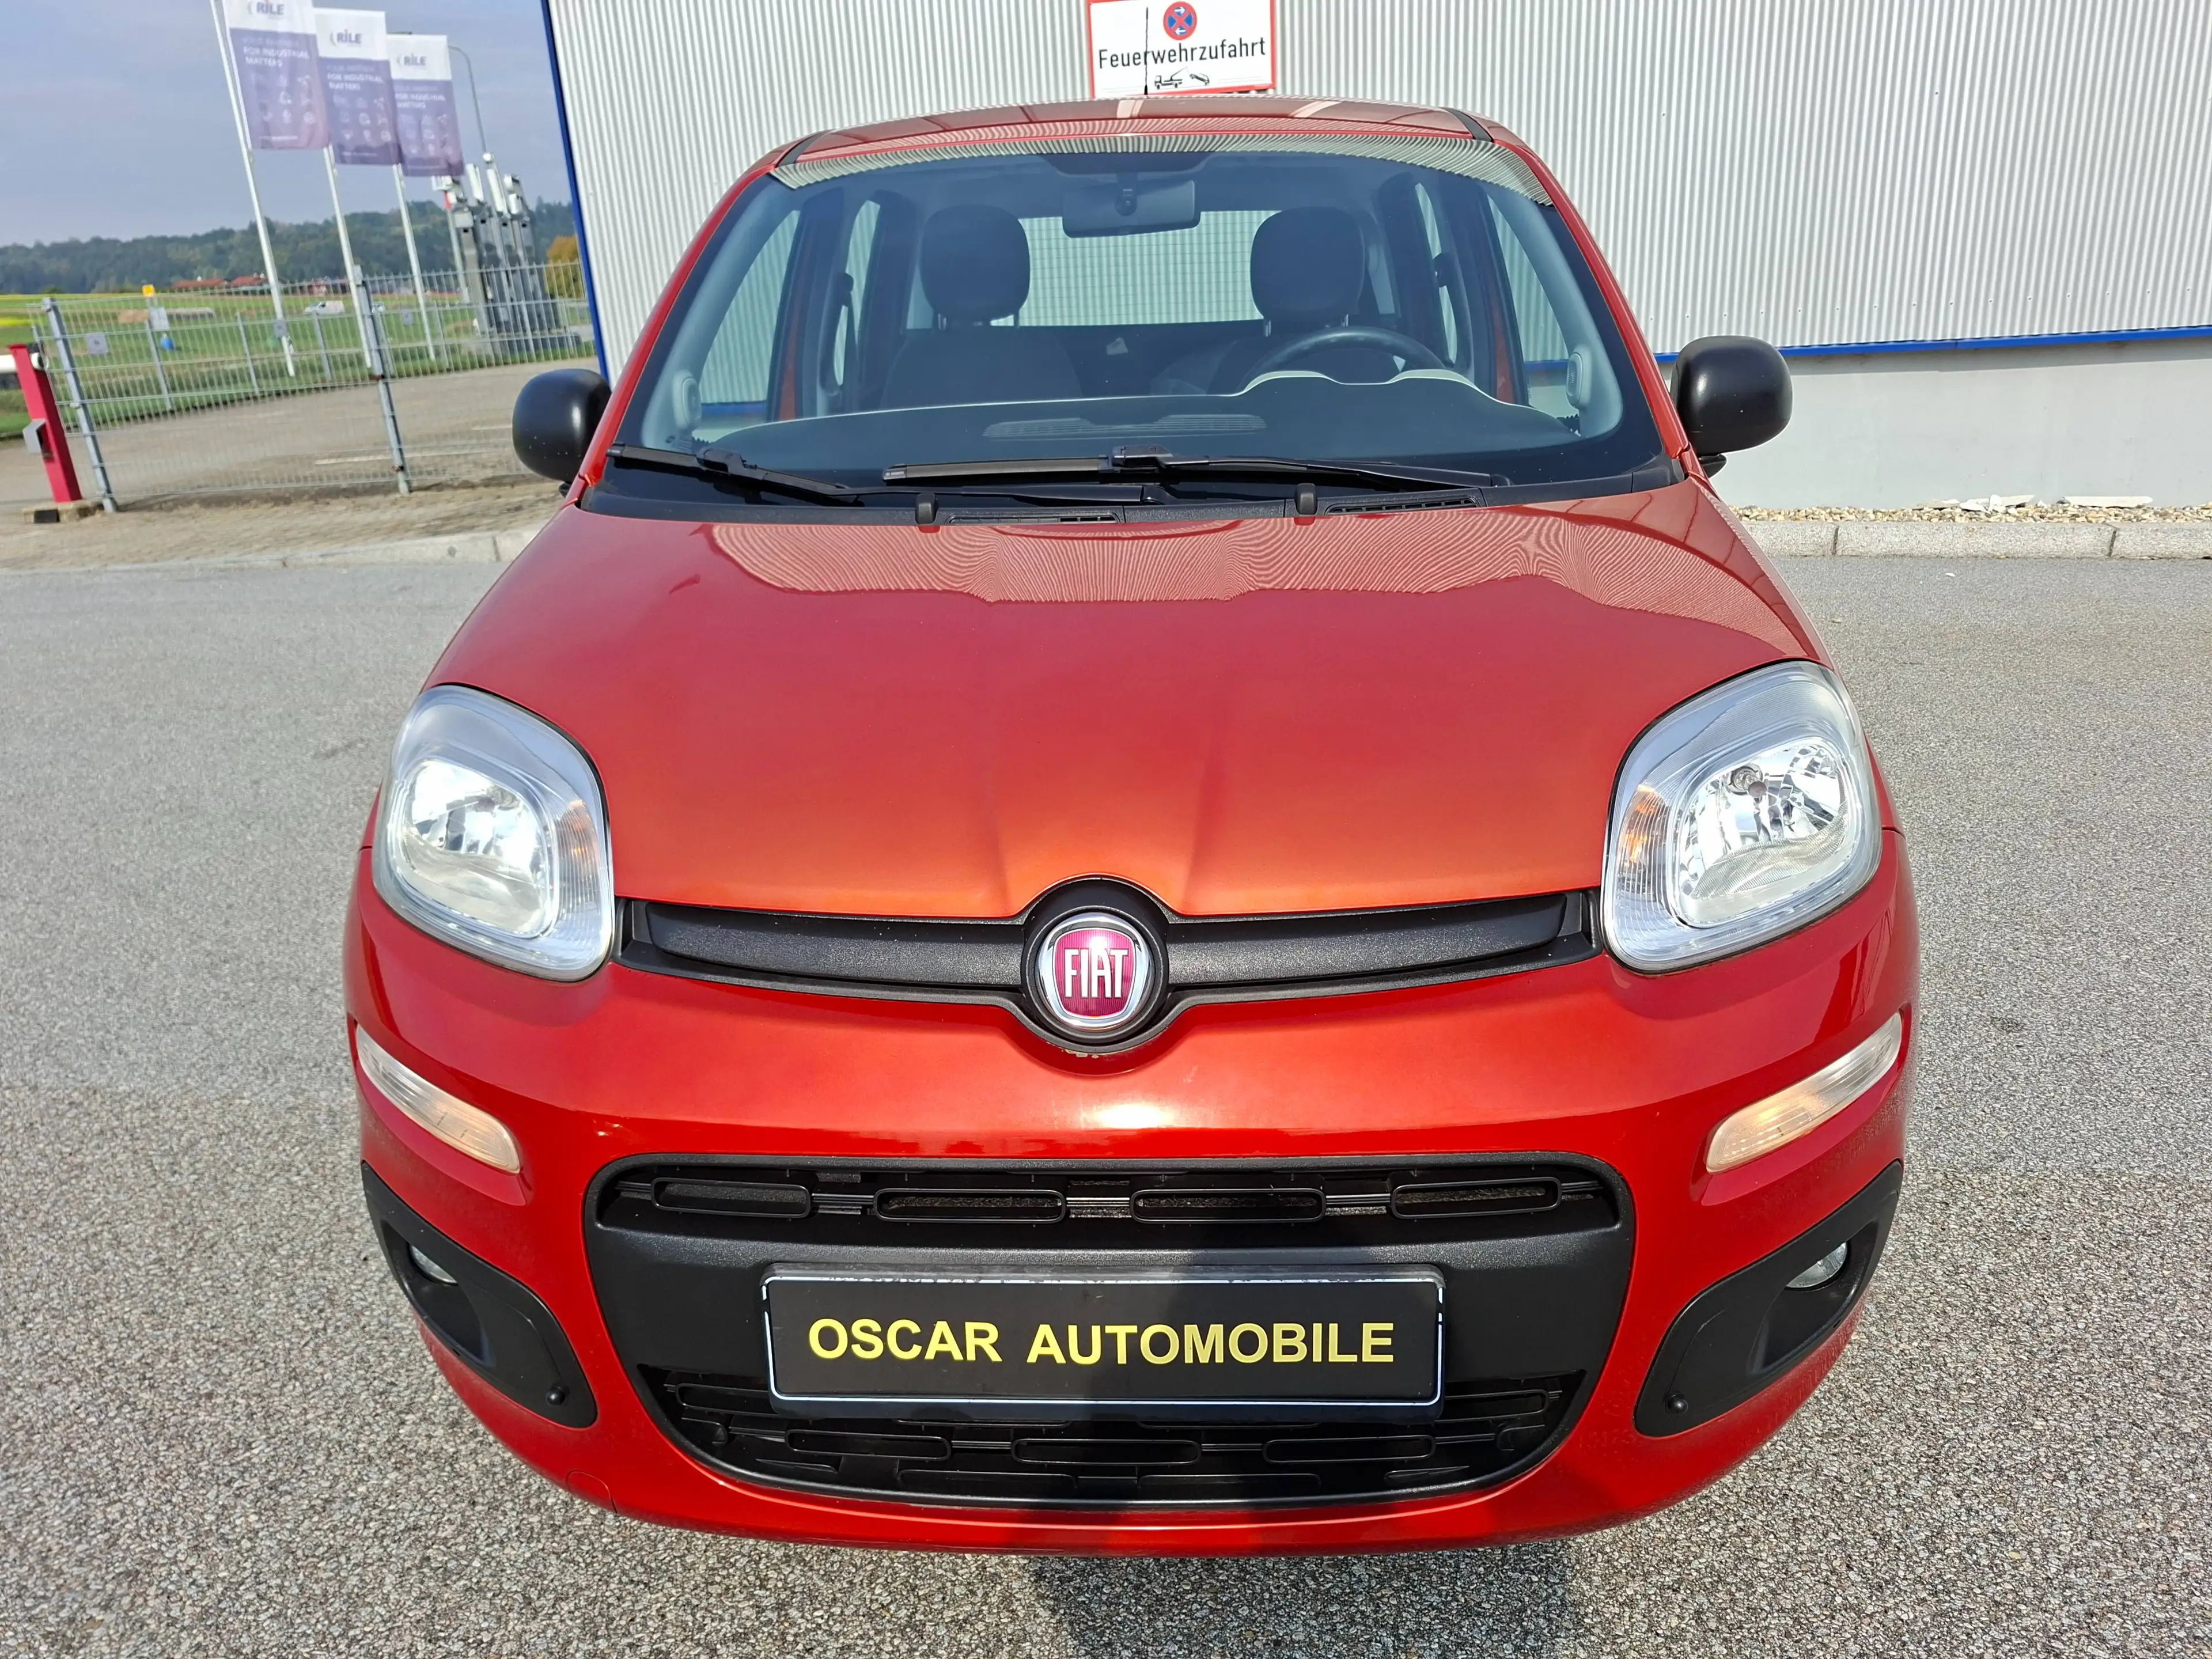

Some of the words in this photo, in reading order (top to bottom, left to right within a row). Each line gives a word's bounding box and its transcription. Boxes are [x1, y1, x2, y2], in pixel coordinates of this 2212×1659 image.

[1099, 37, 1266, 69] Feuerwehrzufahrt
[1065, 948, 1130, 999] FIAT
[808, 1317, 1001, 1362] OSCAR
[1026, 1322, 1395, 1365] AUTOMOBILE
